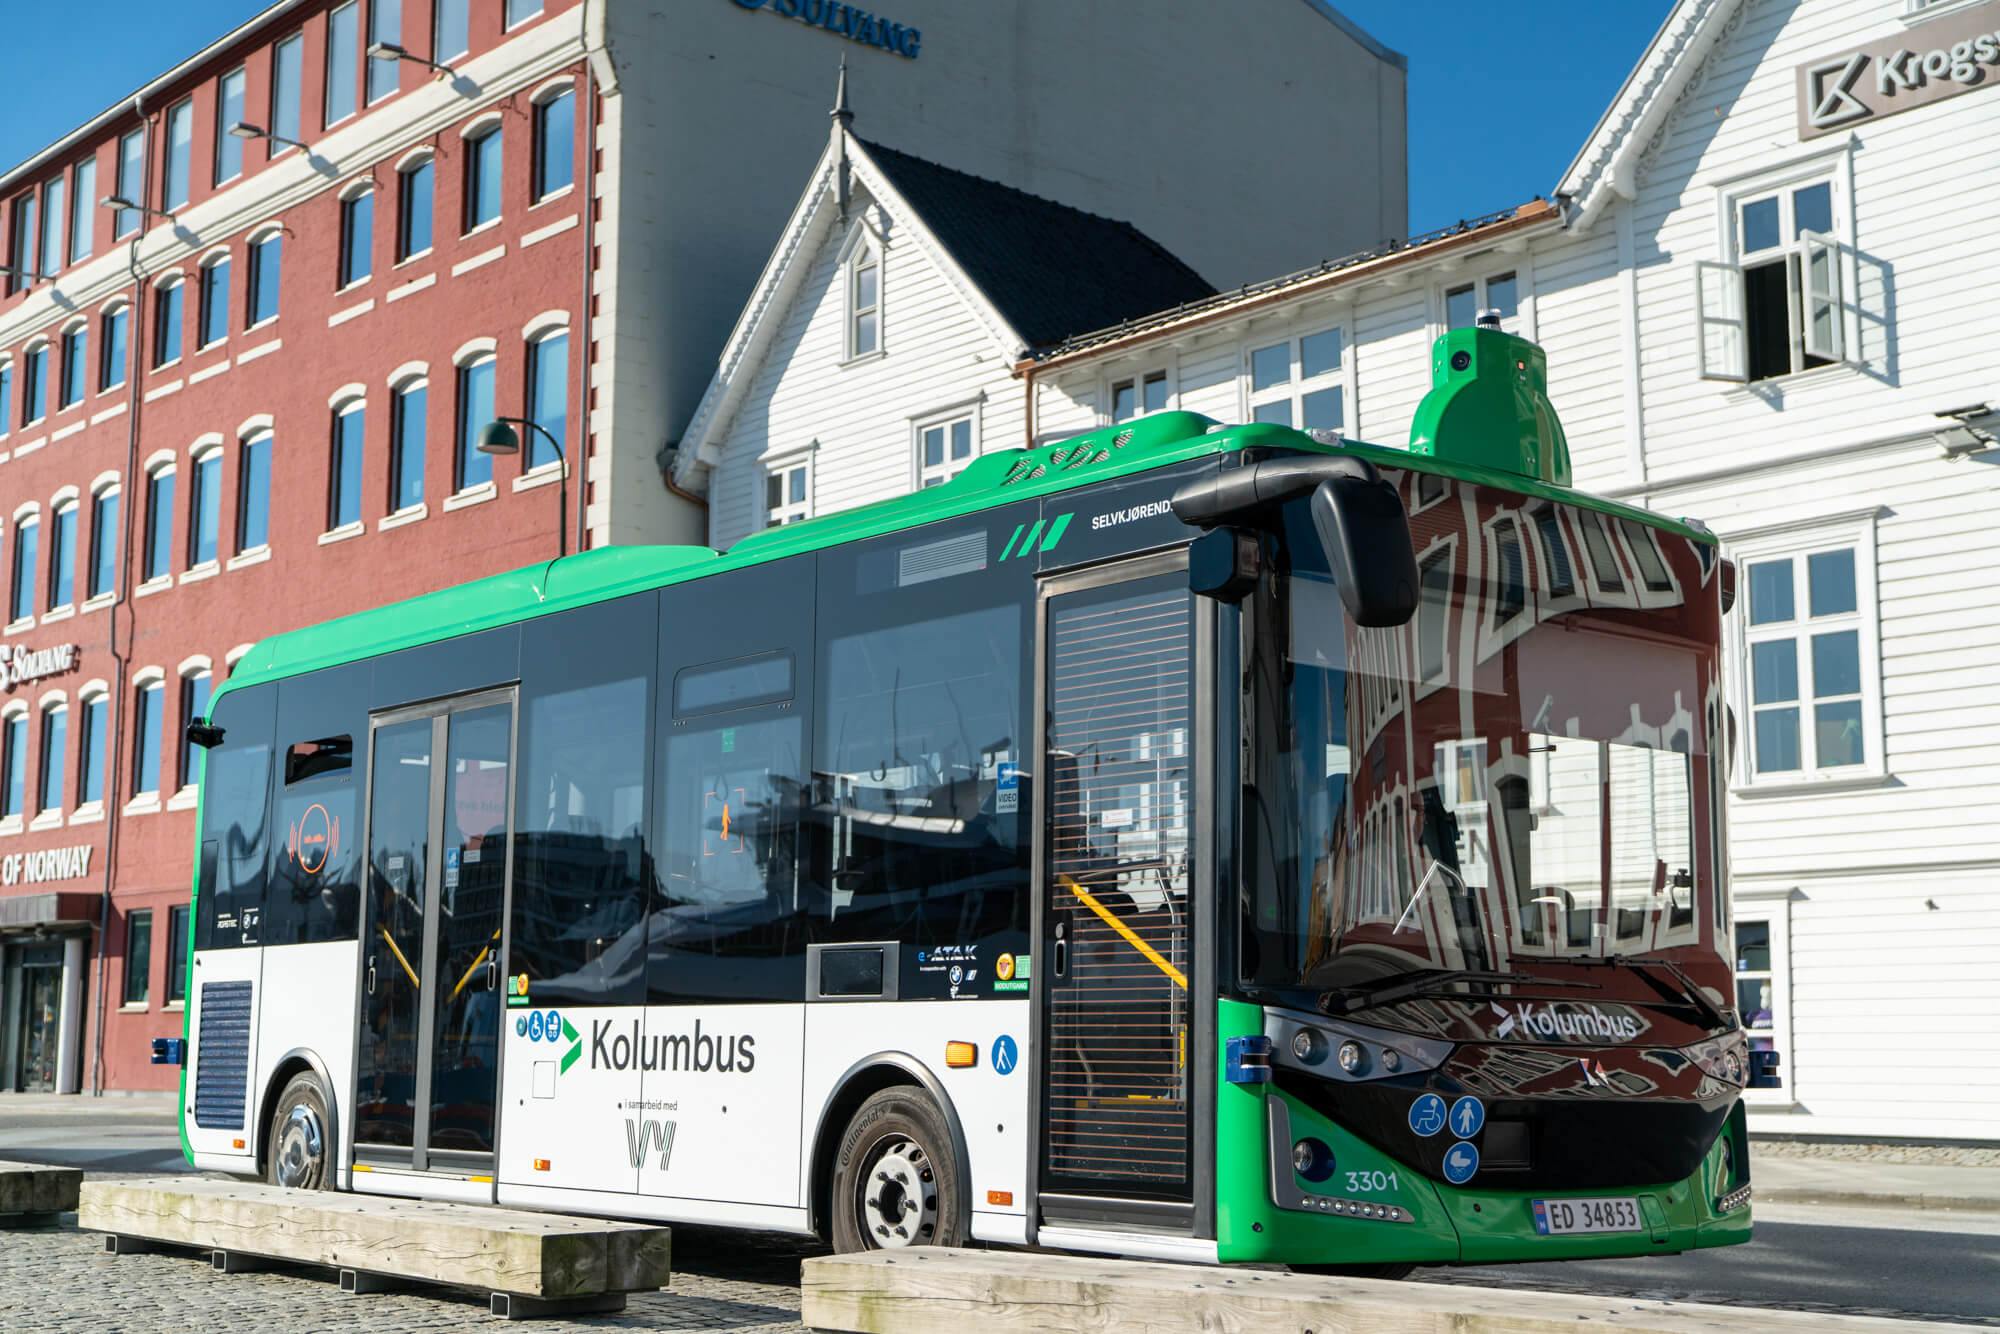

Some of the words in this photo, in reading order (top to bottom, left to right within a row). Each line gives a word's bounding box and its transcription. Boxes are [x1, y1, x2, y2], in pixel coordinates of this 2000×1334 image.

[1876, 31, 2000, 94] Krogs
[1092, 500, 1174, 530] SELVKJØREND
[3, 854, 23, 886] OF
[24, 844, 92, 884] NORWAY
[1516, 1002, 1637, 1039] Kolumbus
[591, 1018, 756, 1073] Kolumbus
[628, 1099, 662, 1110] samarbeid
[662, 1099, 678, 1111] med
[1345, 1170, 1399, 1192] 3301
[1549, 1203, 1574, 1229] ED
[1581, 1201, 1637, 1228] 34853
